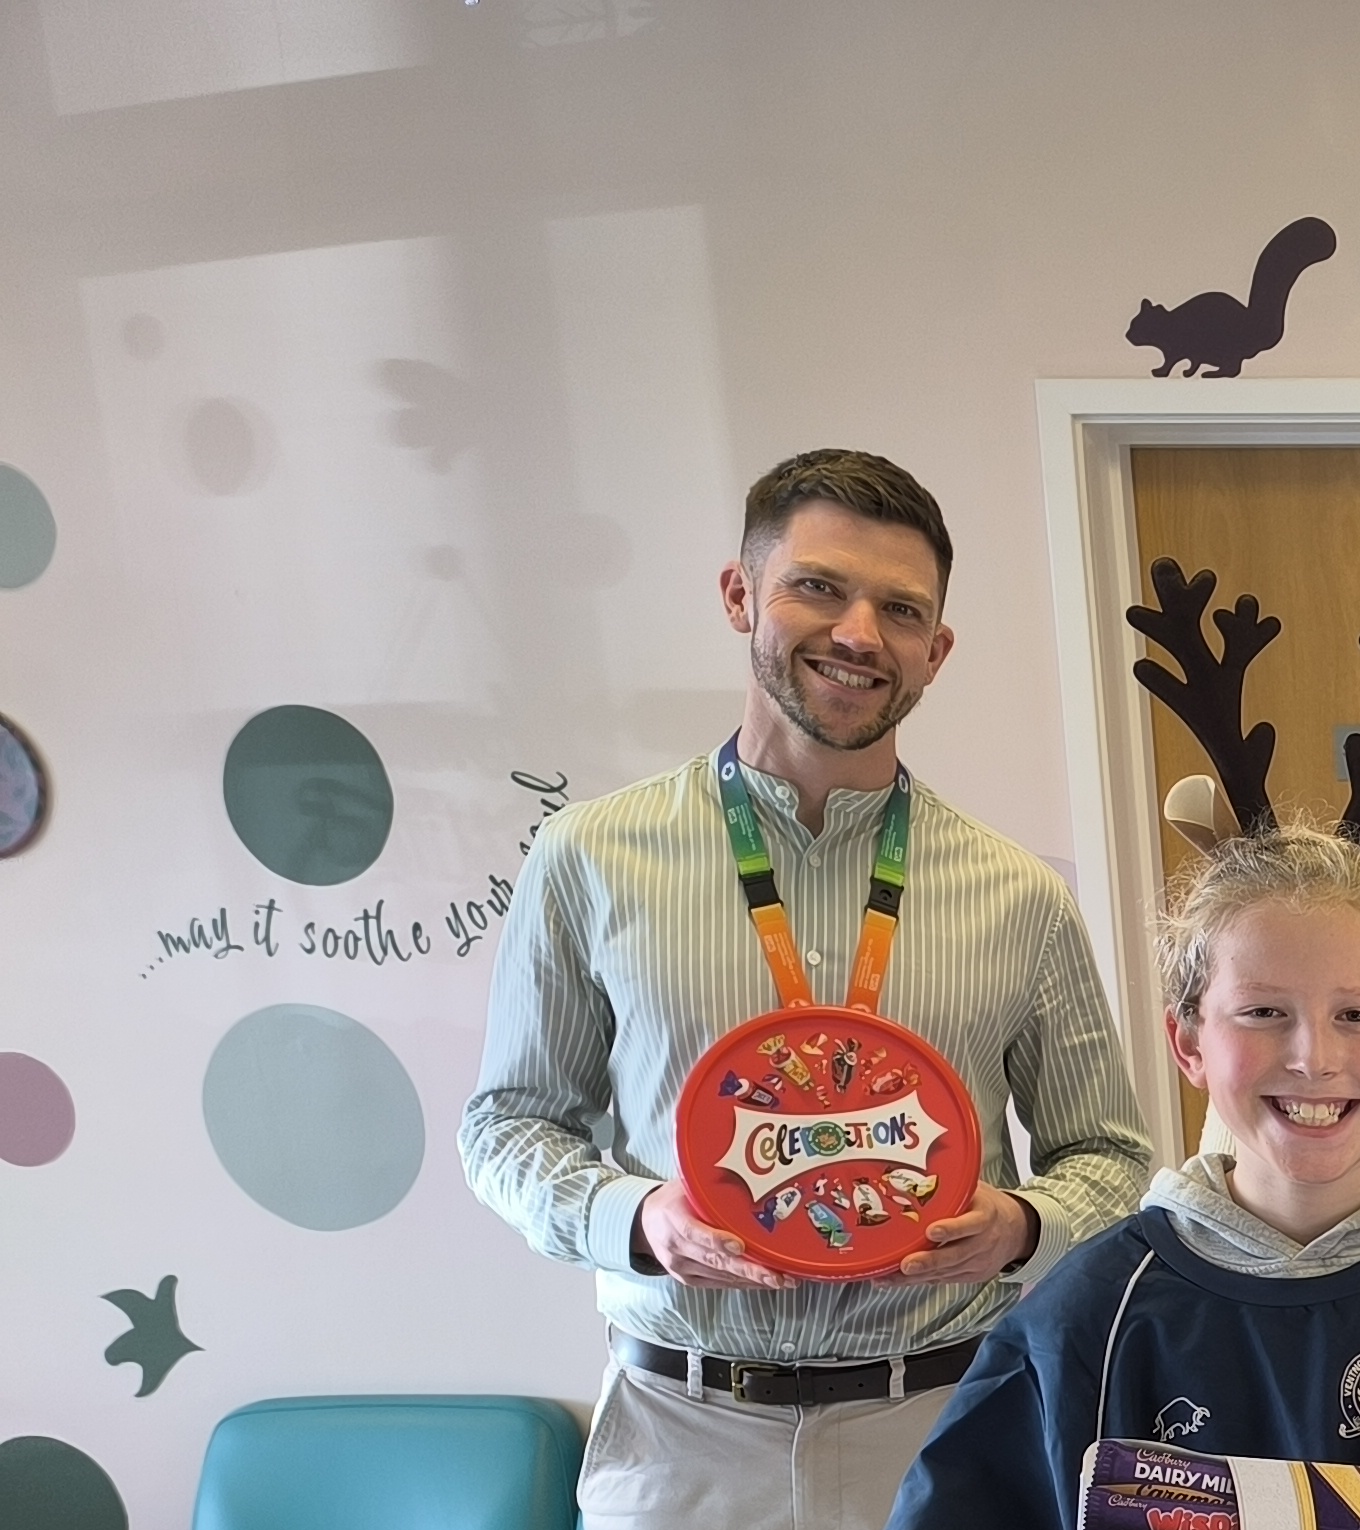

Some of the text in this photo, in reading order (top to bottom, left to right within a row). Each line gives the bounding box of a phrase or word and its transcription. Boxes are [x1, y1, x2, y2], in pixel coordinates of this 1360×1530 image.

[252, 899, 283, 958] it
[299, 899, 432, 966] soothe
[1137, 1449, 1190, 1469] Cadbury
[1135, 1463, 1234, 1494] DAIRY MIL
[1108, 1495, 1148, 1511] Cadbury
